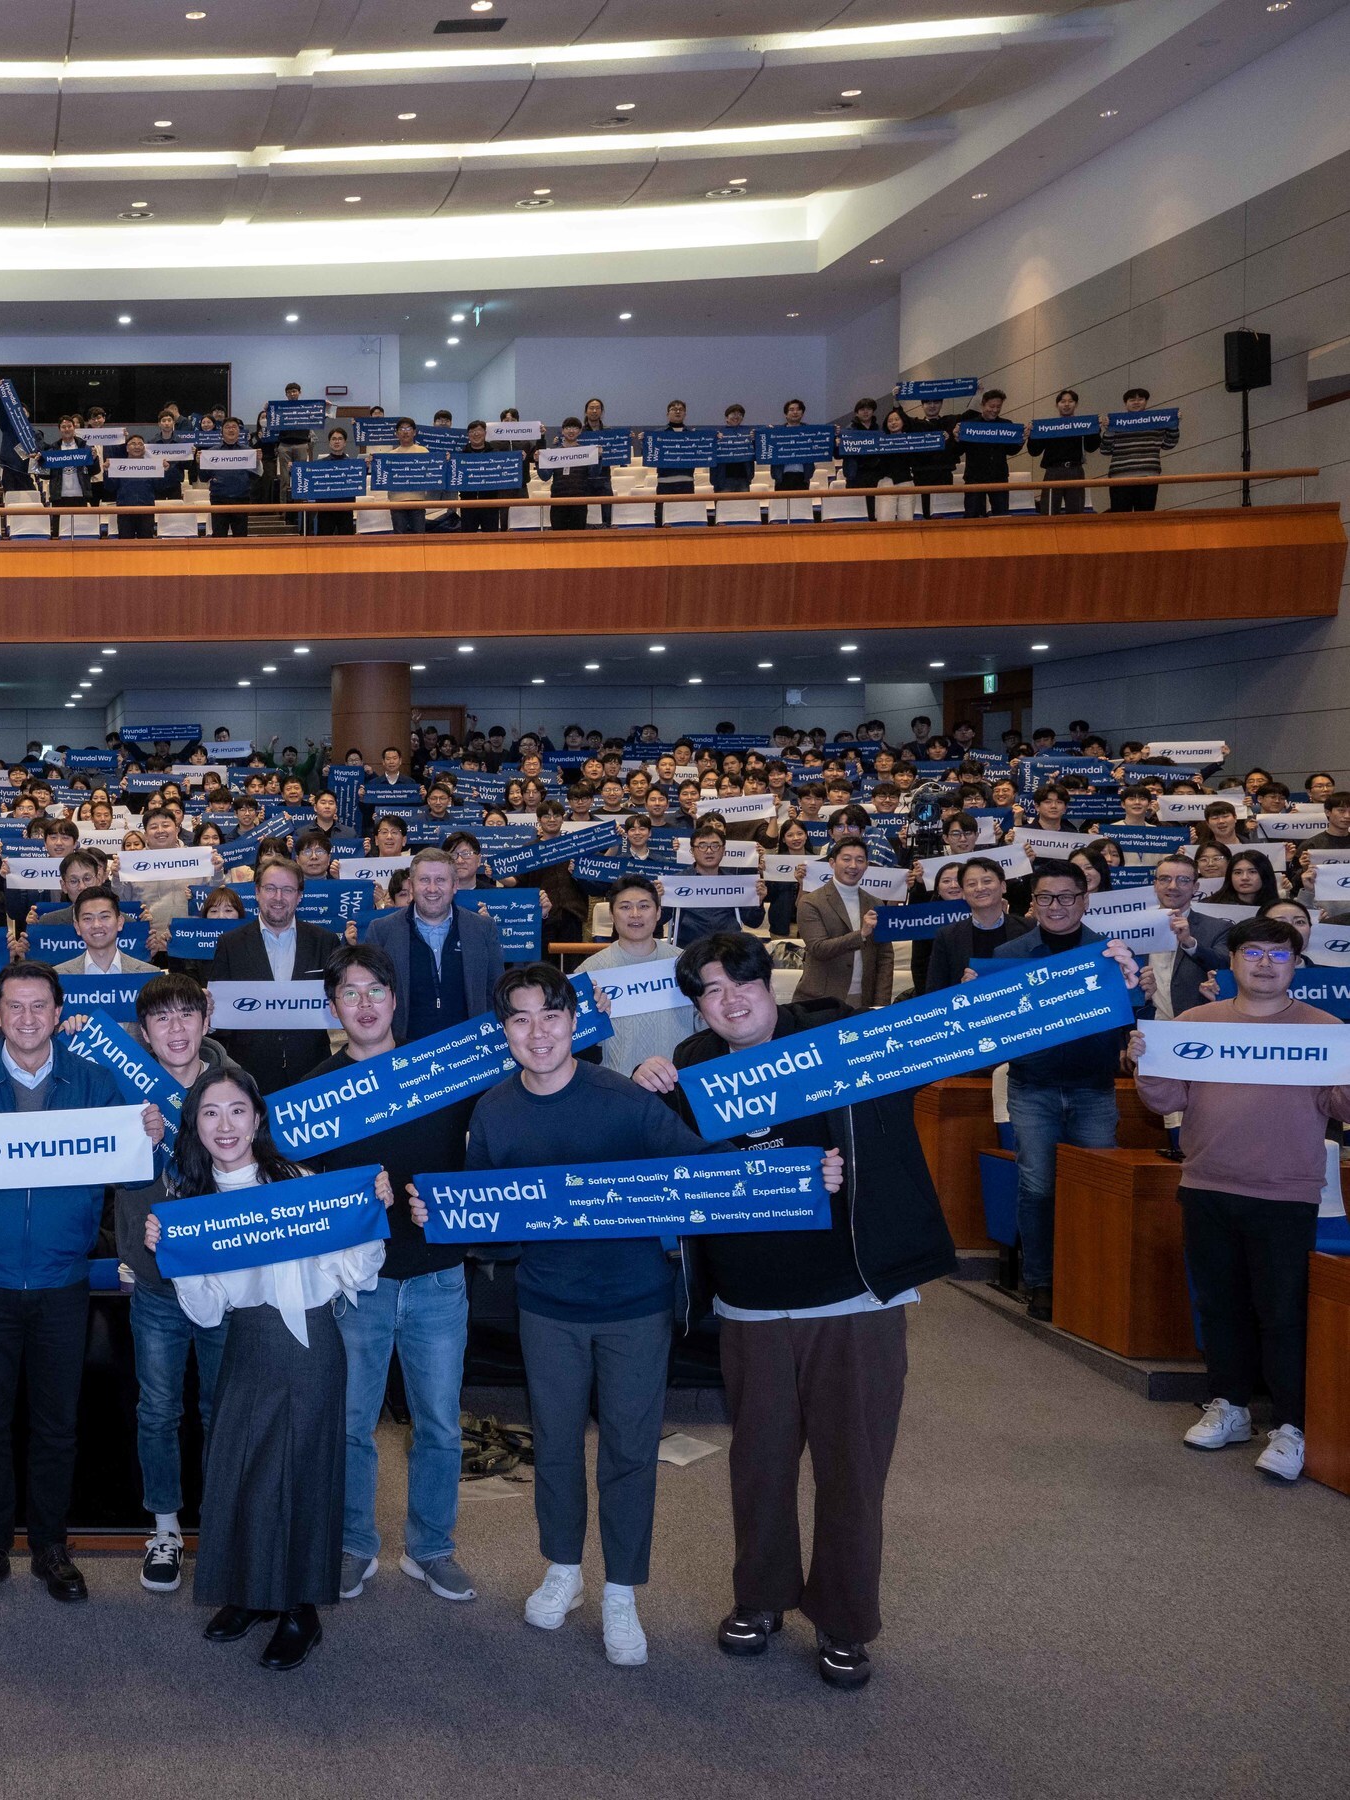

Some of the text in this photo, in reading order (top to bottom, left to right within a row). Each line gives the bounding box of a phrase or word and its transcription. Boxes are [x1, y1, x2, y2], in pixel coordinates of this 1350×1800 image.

[1039, 421, 1092, 432] Hyundai Way
[1116, 414, 1171, 426] Hyundai Way
[843, 438, 874, 447] Hyundai
[966, 428, 1016, 438] Hyundai Way
[46, 453, 87, 462] Hyundai Way
[560, 453, 589, 461] HYUNDAI
[844, 446, 861, 454] Way
[71, 754, 97, 762] Hyundai
[725, 804, 763, 814] HYUNDAI
[154, 859, 199, 870] HYUNDAI
[493, 849, 534, 867] Hyundai
[579, 857, 620, 870] Hyundai
[496, 863, 518, 875] Way
[579, 866, 601, 877] Way
[696, 887, 744, 896] HYUNDAI
[863, 960, 1095, 1038] Safety and Quality Alignment Progress
[847, 987, 1085, 1066] Integrity Tenacity Resilience Expertise
[82, 1017, 159, 1094] Hyundai
[411, 1033, 477, 1064] Safety and Quality
[805, 1005, 1111, 1102] Agility Data-Driven Thinking Diversity and Inclusion
[1220, 1046, 1328, 1061] HYUNDAI
[400, 1054, 480, 1089] Integrity Tenacity
[701, 1043, 823, 1097] Hyundai
[275, 1070, 379, 1125] Hyundai
[714, 1092, 777, 1123] Way
[282, 1116, 341, 1148] Way
[8, 1136, 116, 1159] HYUNDAI
[588, 1163, 811, 1185] Safety and Quality Alignment Progress
[432, 1179, 547, 1207] Hyundai
[569, 1186, 797, 1206] Integrity Tenacity Resilience Expertise
[167, 1191, 369, 1239] Stay Humble, Stay Hungry,
[439, 1208, 500, 1233] Way
[525, 1208, 814, 1229] Agility Data-Driven Thinking Diversity and Inclusion
[212, 1217, 330, 1251] and Work Hard!
